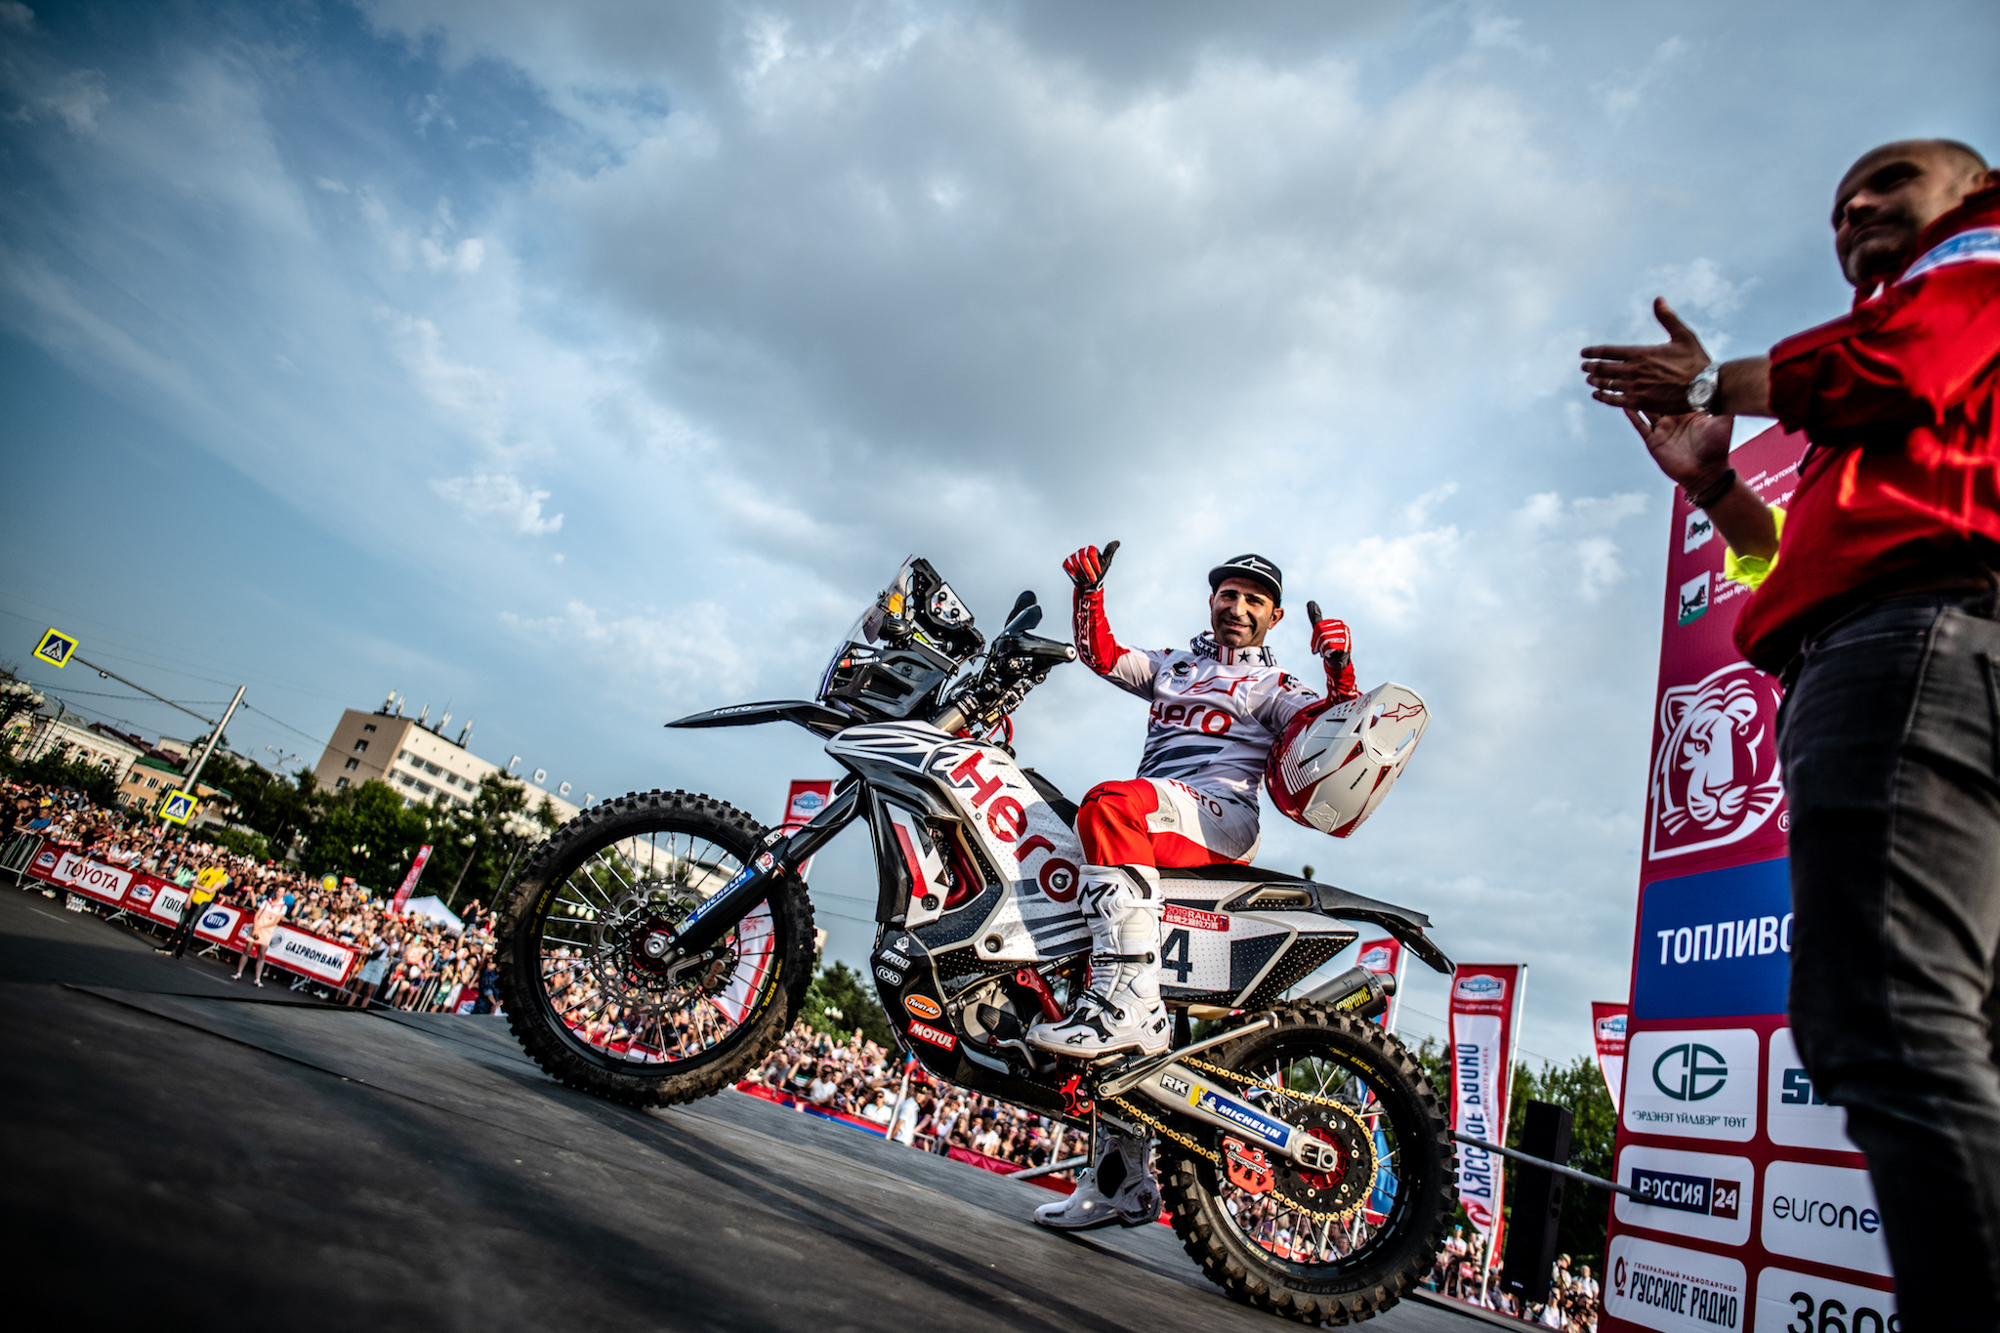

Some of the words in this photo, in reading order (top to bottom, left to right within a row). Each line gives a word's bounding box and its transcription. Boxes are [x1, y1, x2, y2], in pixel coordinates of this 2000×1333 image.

[1150, 700, 1233, 735] Hero
[1166, 778, 1223, 818] Hero
[950, 750, 1079, 904] Hero
[63, 859, 120, 892] TOYOTA
[535, 889, 551, 914] EXCEL
[697, 871, 747, 915] MICHELIN
[207, 914, 227, 928] ОПТИ
[286, 941, 344, 970] GAZPROMBANK
[1161, 928, 1193, 983] 4
[878, 967, 899, 984] roto
[762, 981, 777, 1007] EXCEL
[908, 997, 926, 1011] Twin
[925, 1005, 939, 1015] Air
[910, 1022, 953, 1048] MOTUL
[1350, 1056, 1373, 1075] EXCEL
[1161, 1073, 1188, 1095] RK
[1218, 1104, 1281, 1139] MICHELIN
[1640, 1176, 1704, 1206] РОССИЯ
[1714, 1187, 1738, 1210] 24
[1634, 1262, 1681, 1279] ГЕНЕРАЛЬНЫЙ
[1682, 1273, 1738, 1293] РАДИОПАРТНЕР
[1630, 1271, 1688, 1315] РУССКОЕ
[1690, 1286, 1738, 1329] РАДИО
